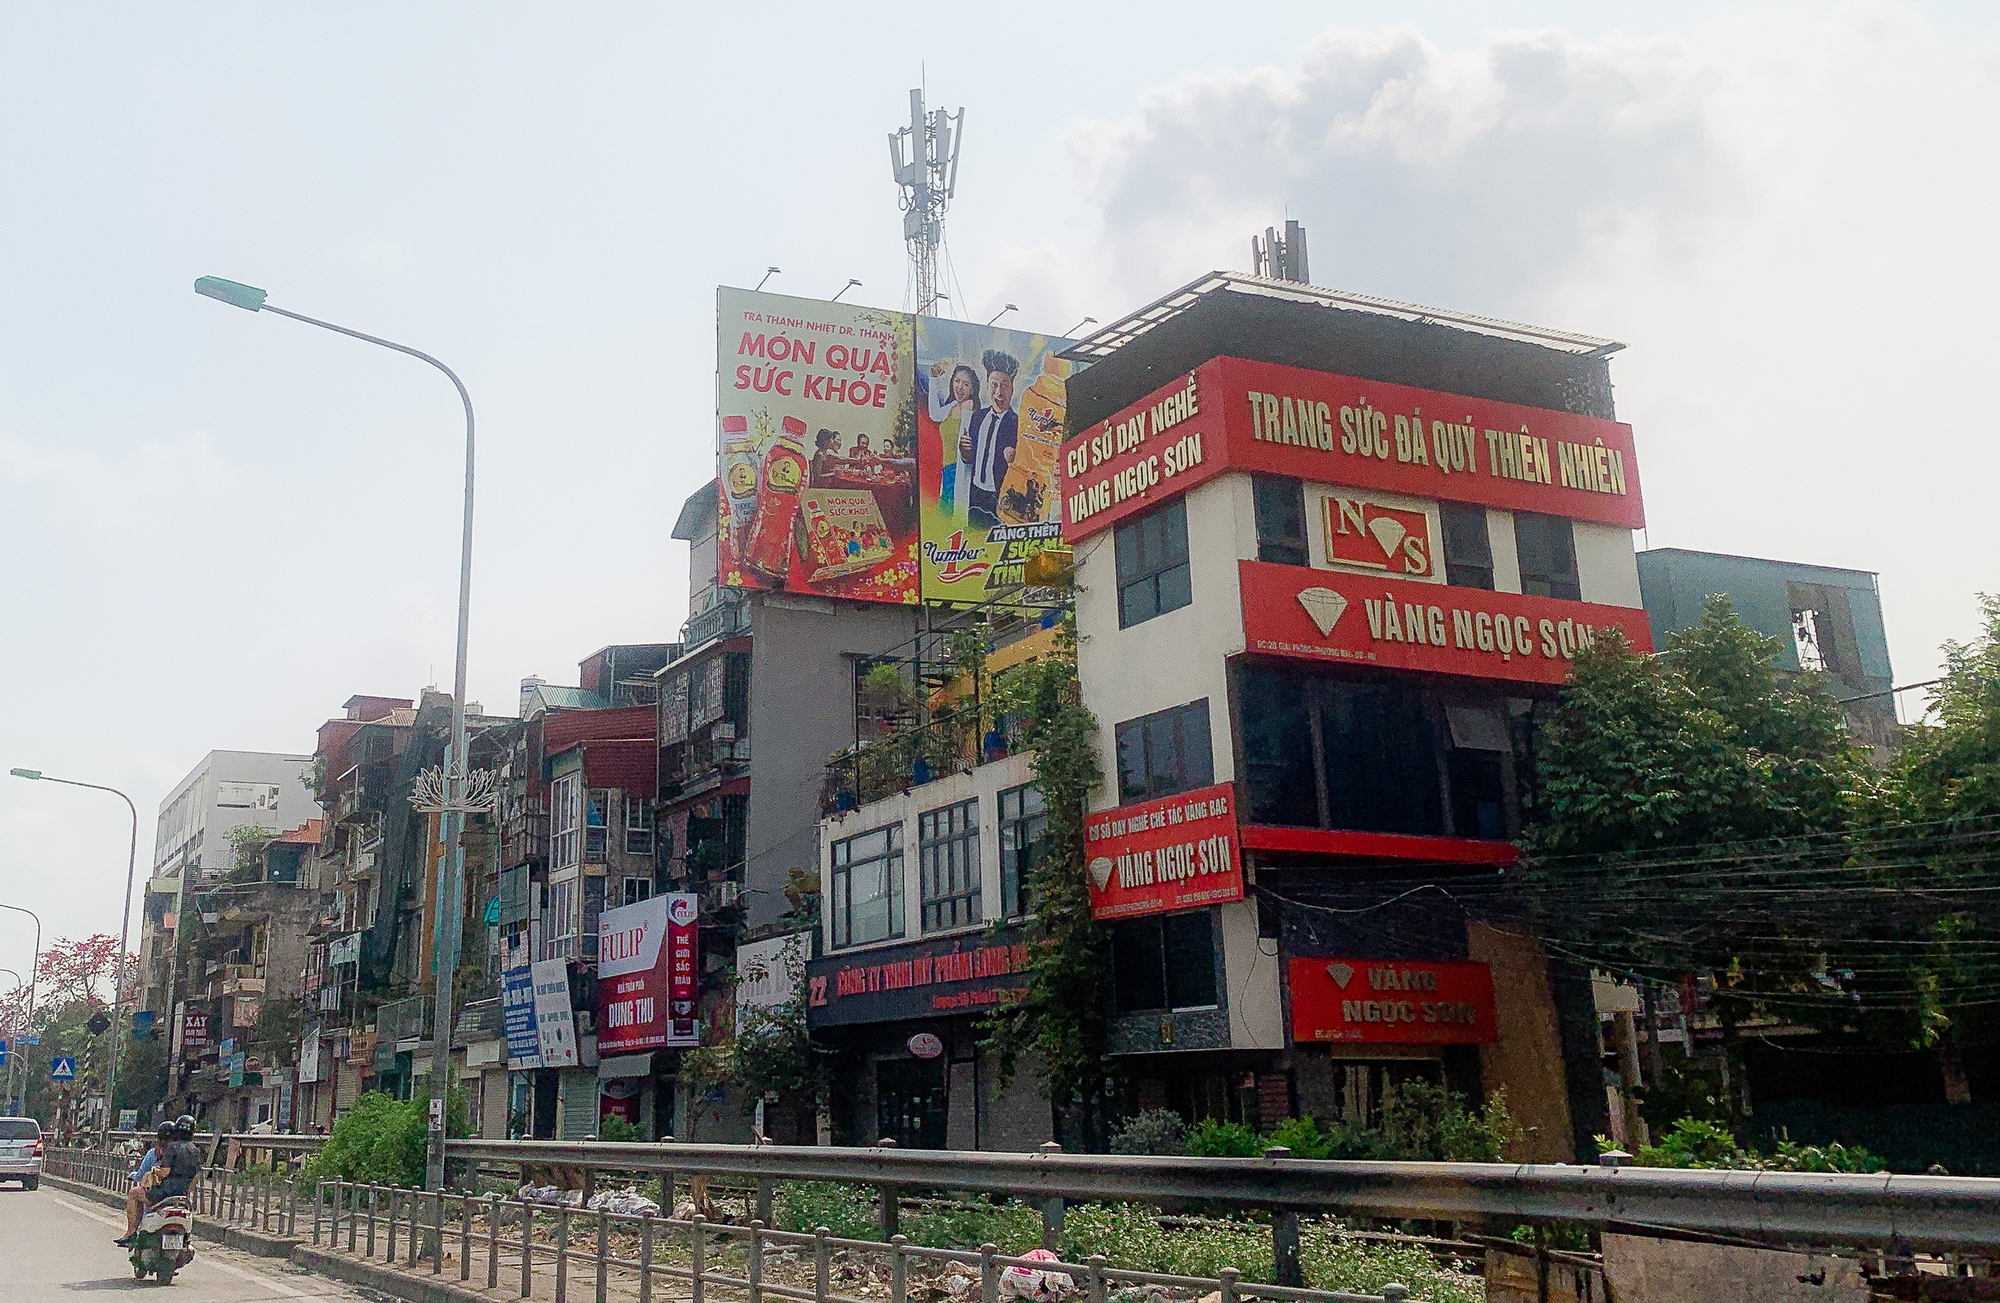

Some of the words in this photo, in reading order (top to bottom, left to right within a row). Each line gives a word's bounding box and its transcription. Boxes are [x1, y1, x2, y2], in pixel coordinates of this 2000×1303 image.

[766, 315, 803, 328] THANH
[806, 321, 836, 335] NHIỆT
[839, 326, 856, 337] DR.
[859, 329, 896, 342] THANH
[737, 331, 817, 365] MÓN
[825, 340, 891, 376] QUÀ
[733, 362, 794, 396] SỨC
[803, 372, 888, 409] KHỎE
[1067, 440, 1089, 479] CƠ
[1091, 420, 1113, 467] SỞ
[1116, 411, 1147, 454] DẠY
[1150, 370, 1199, 436] NGHỀ
[1248, 391, 1335, 451] TRANG
[1339, 396, 1390, 460] SỨC
[1394, 407, 1429, 466] ĐÁ
[1431, 415, 1477, 475] QUÝ
[1484, 424, 1552, 485] THIÊN
[1557, 436, 1627, 496] NHIÊN
[1068, 479, 1111, 525] VÀNG
[1113, 455, 1159, 504] NGỌC
[1163, 433, 1202, 478] SƠN
[992, 527, 1027, 541] TĂNG
[1028, 523, 1059, 539] THÊM
[923, 538, 986, 565] Number
[1364, 592, 1447, 648] VÀNG
[1452, 608, 1533, 661] NGỌC
[1100, 817, 1110, 840] SỞ
[1150, 804, 1166, 829] CHẾ
[1167, 803, 1183, 826] TÁC
[1184, 799, 1208, 822] VÀNG
[1209, 796, 1228, 820] BẠC
[1117, 848, 1154, 889] VÀNG
[1156, 842, 1196, 886] NGỌC
[1199, 834, 1232, 876] SƠN
[676, 933, 690, 945] THẾ
[675, 959, 691, 972] SẮC
[866, 965, 881, 993] TY
[1367, 964, 1439, 992] VÀNG
[608, 1002, 634, 1029] DUNG
[636, 997, 654, 1024] THU
[1342, 1000, 1417, 1028] NGỌC
